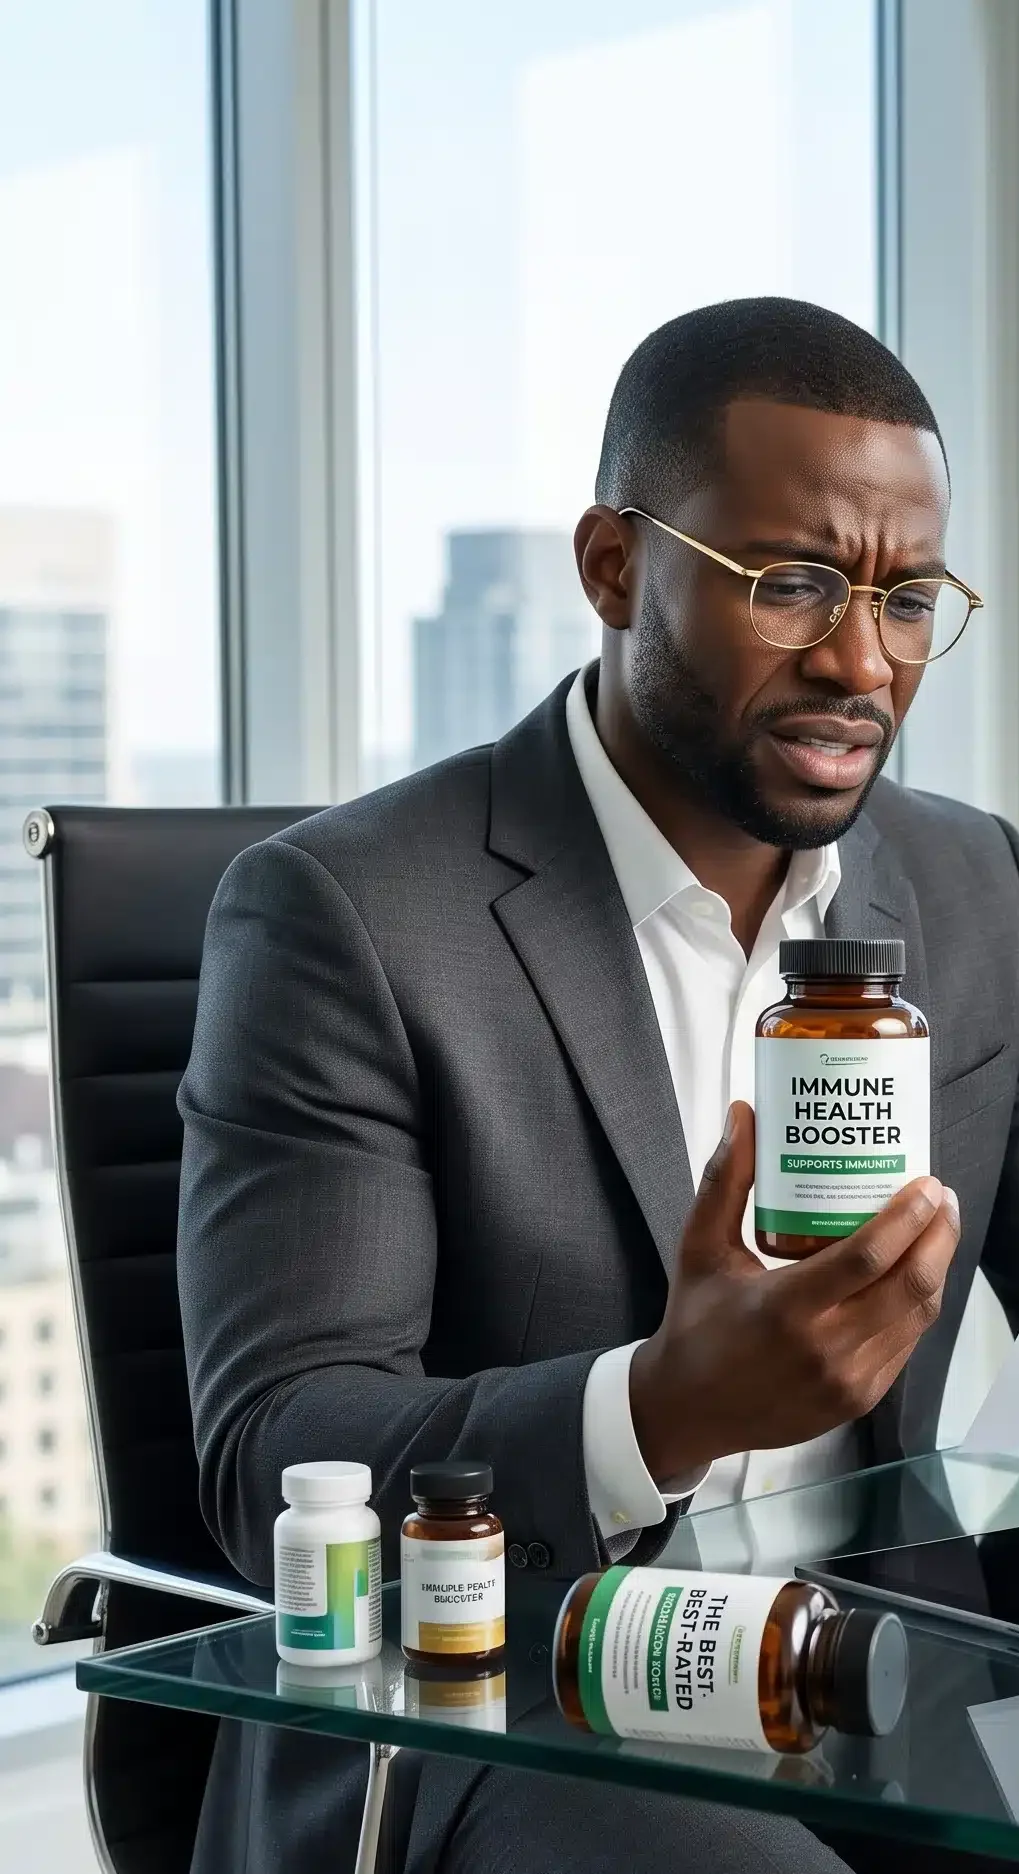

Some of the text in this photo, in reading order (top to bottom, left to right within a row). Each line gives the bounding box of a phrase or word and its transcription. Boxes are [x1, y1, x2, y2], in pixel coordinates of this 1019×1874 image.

[792, 1077, 894, 1096] IMMUNE
[795, 1101, 892, 1121] HEALTH
[785, 1125, 901, 1145] BOOSTER
[787, 1158, 899, 1170] SUPPORTS IMMUNITY
[703, 1595, 728, 1631] THE
[675, 1589, 706, 1710] BEST-RATED
